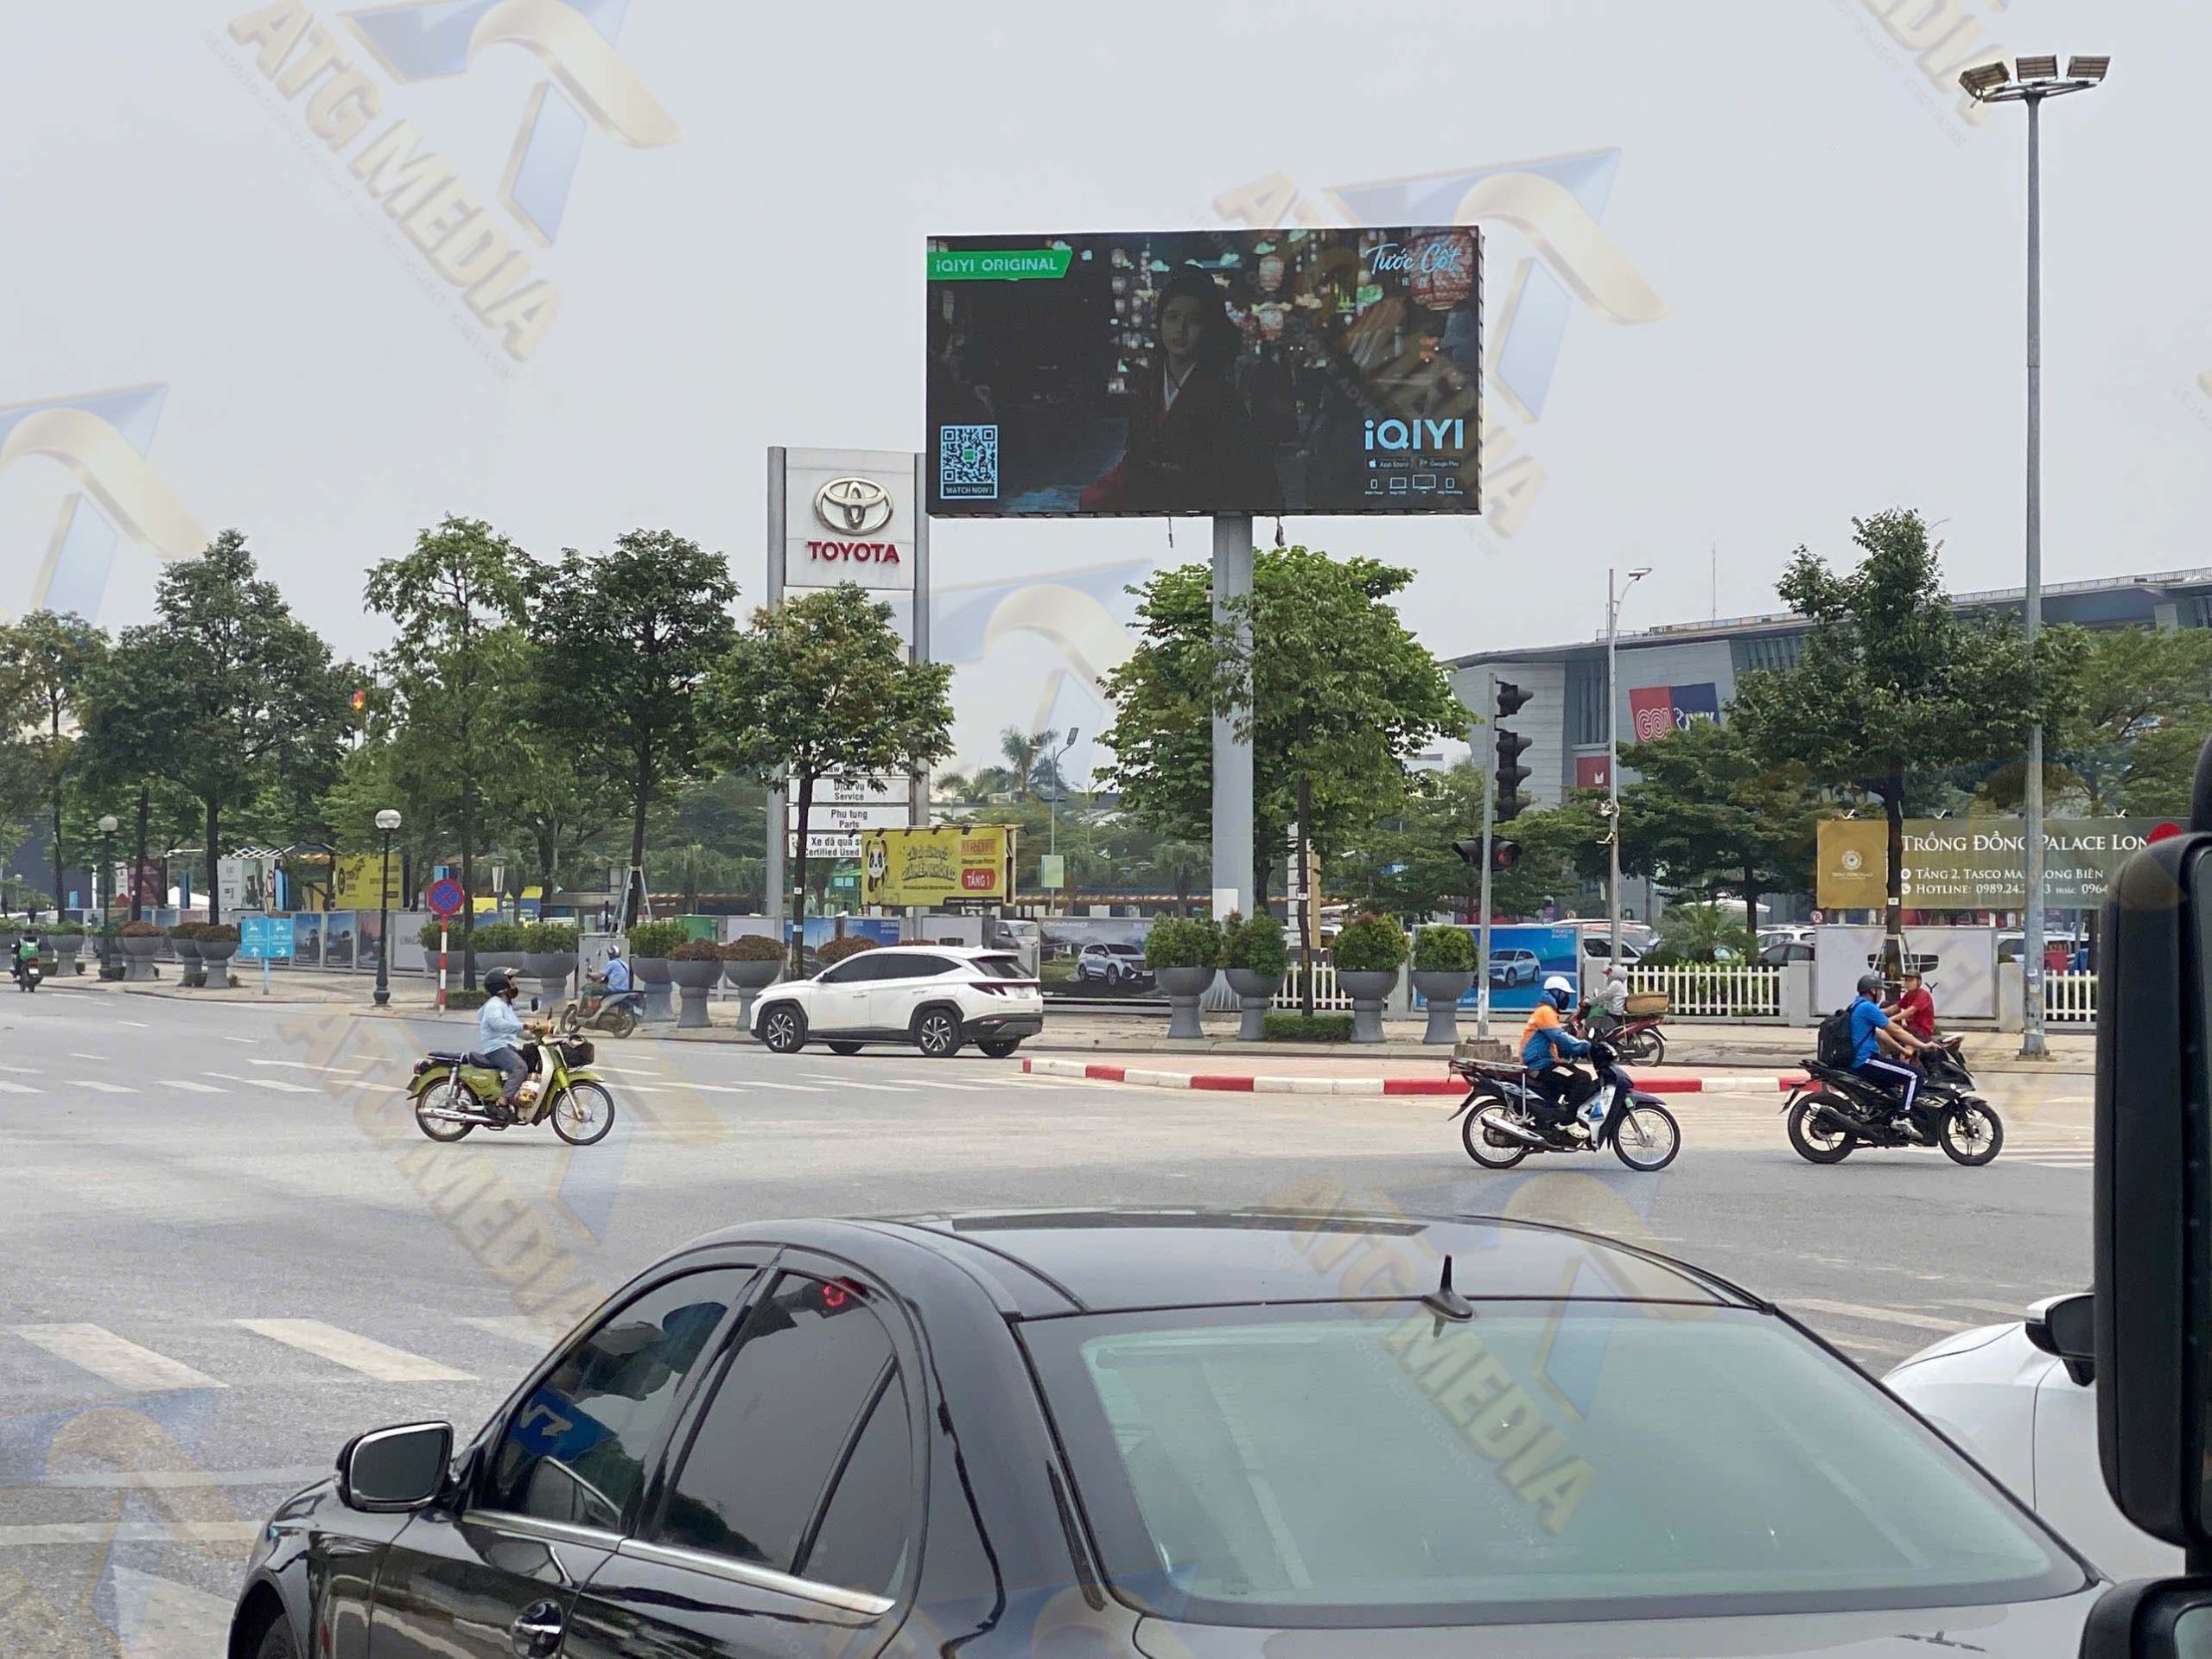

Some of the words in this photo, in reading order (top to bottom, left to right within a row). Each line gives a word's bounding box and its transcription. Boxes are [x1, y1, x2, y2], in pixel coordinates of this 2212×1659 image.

[981, 258, 1058, 271] ORIGINAL
[1364, 418, 1464, 450] iQIYI
[807, 541, 900, 563] TOYOTA
[811, 836, 823, 847] Xe
[840, 848, 860, 856] Used
[1964, 868, 2001, 880] TASCO
[2042, 869, 2072, 880] ONG
[2075, 868, 2104, 879] BIÊN
[1916, 884, 1971, 894] HOTLINE:
